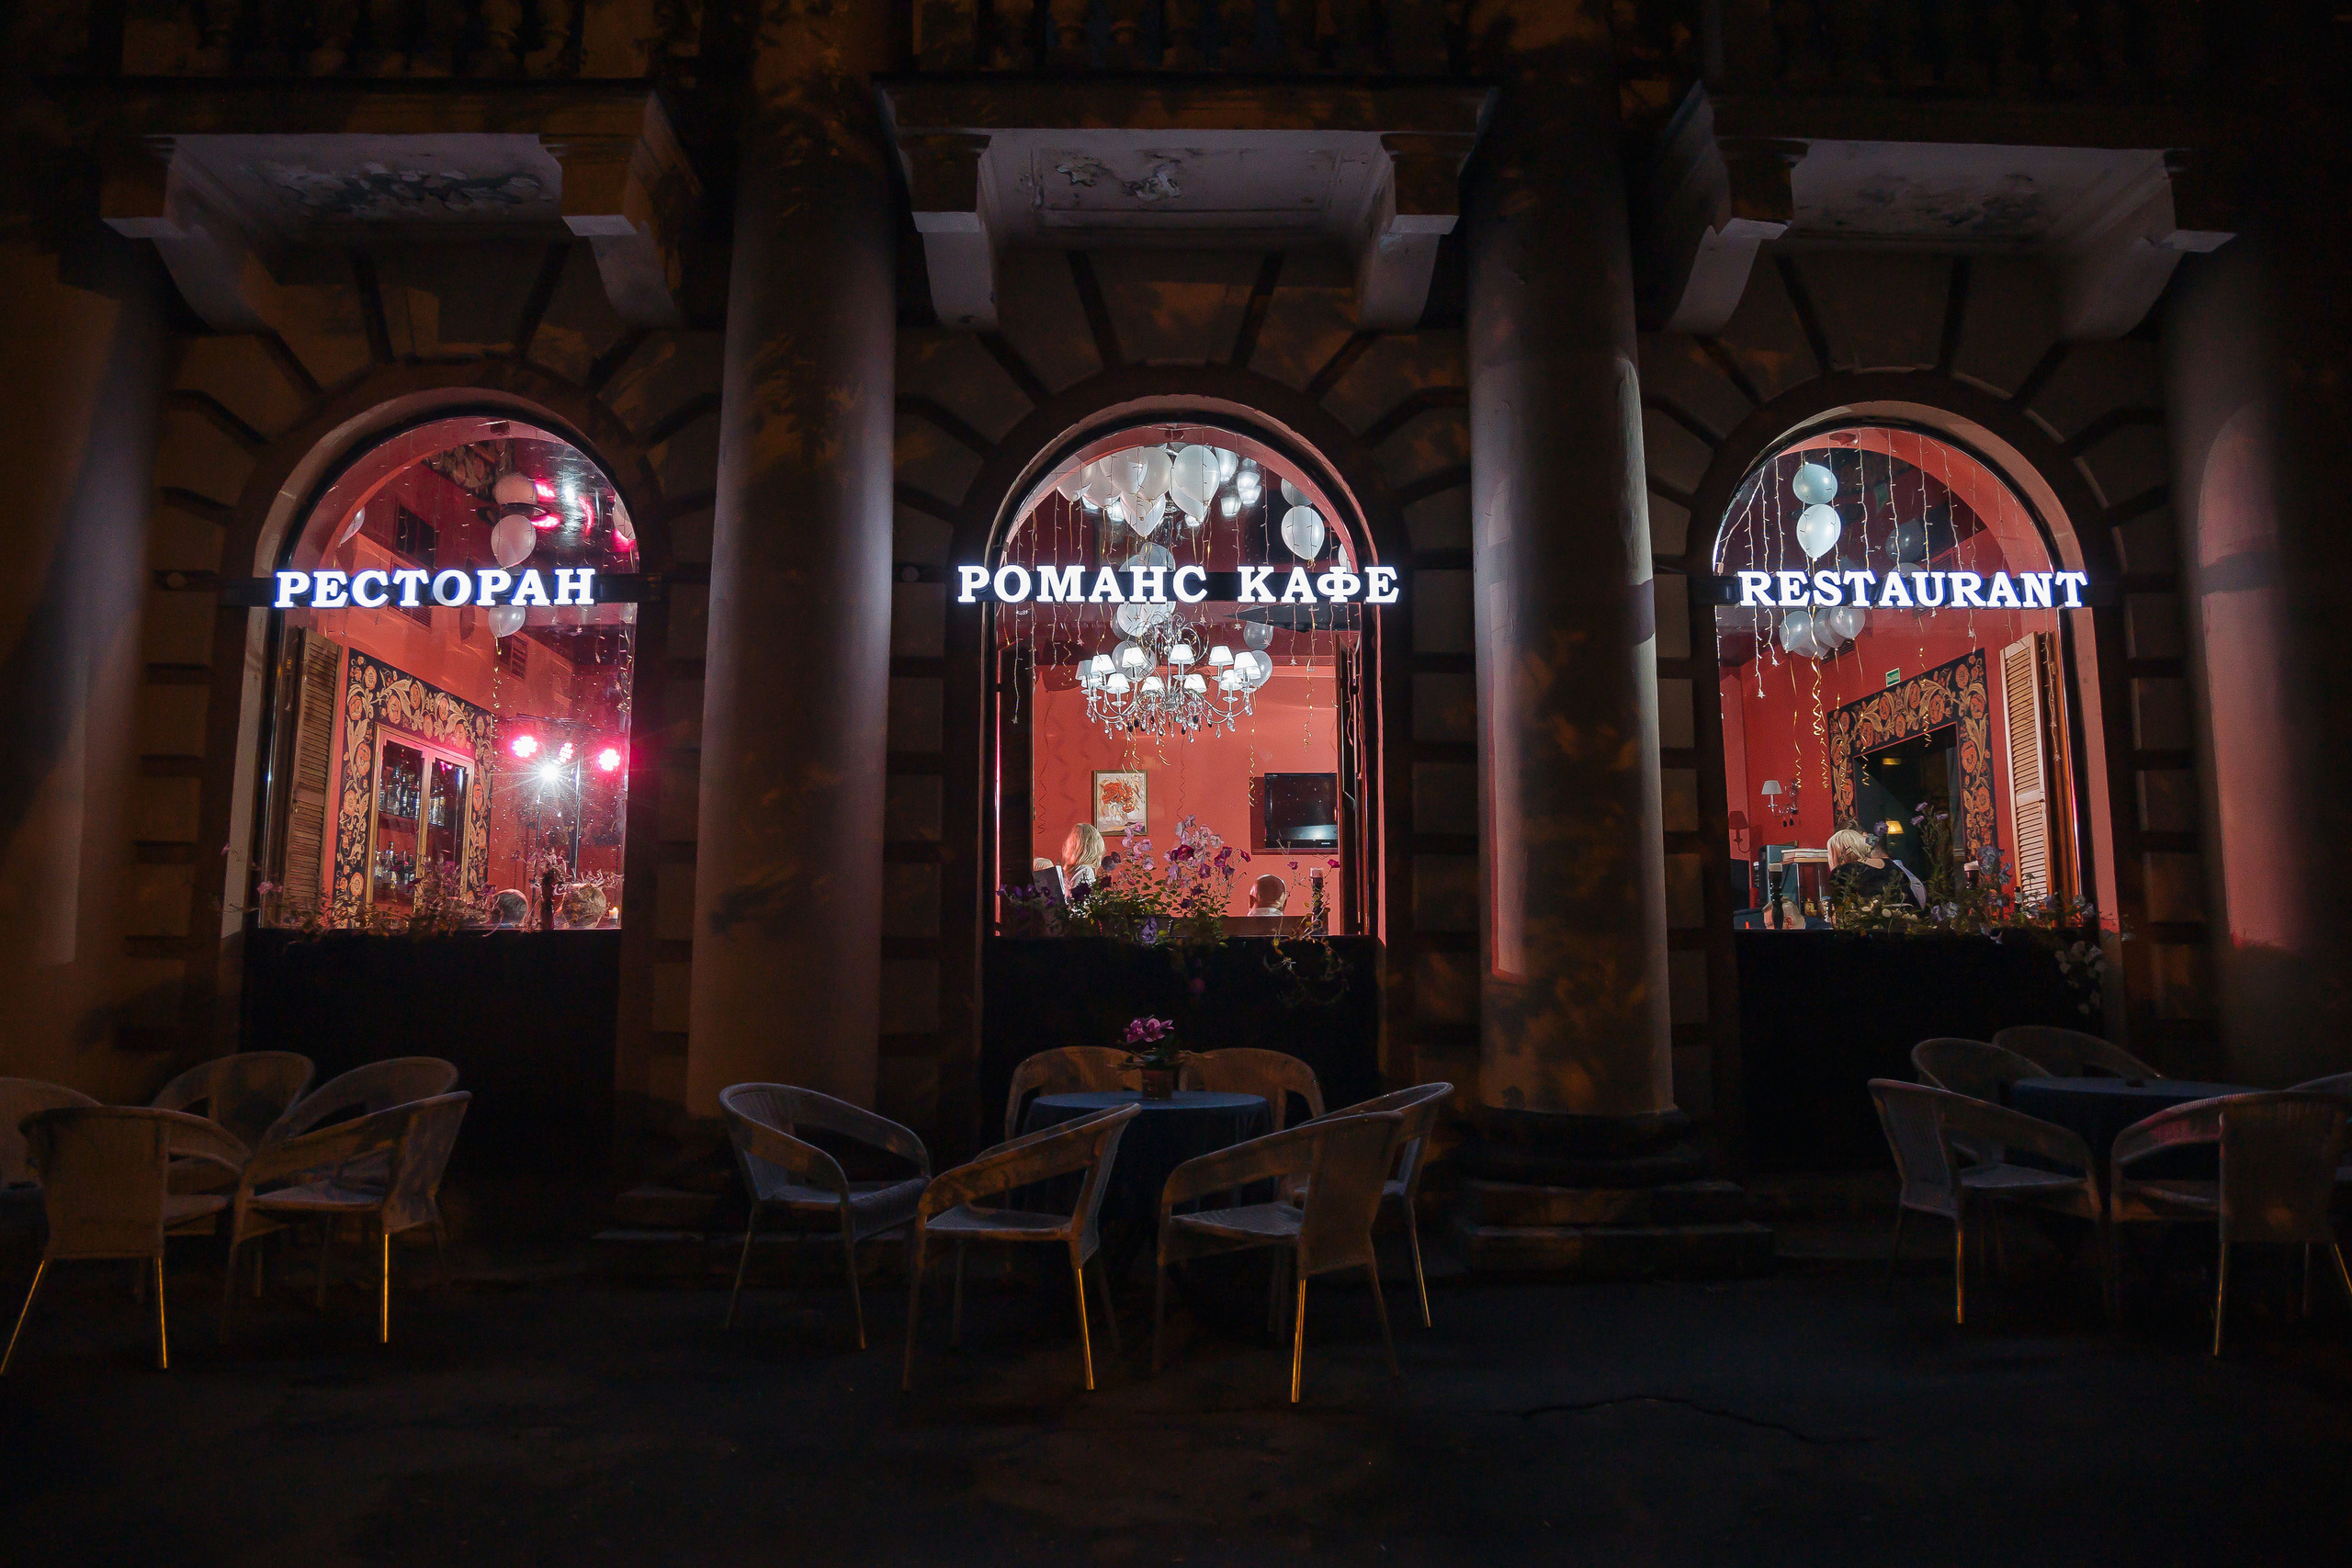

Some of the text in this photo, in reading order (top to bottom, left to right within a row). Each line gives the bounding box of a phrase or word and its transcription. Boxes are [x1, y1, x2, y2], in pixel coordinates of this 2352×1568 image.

[274, 568, 596, 608] РЕСТОРАН
[957, 565, 1399, 604] РОМАНС КАФЕ
[1736, 570, 2088, 608] RESTAURANT
